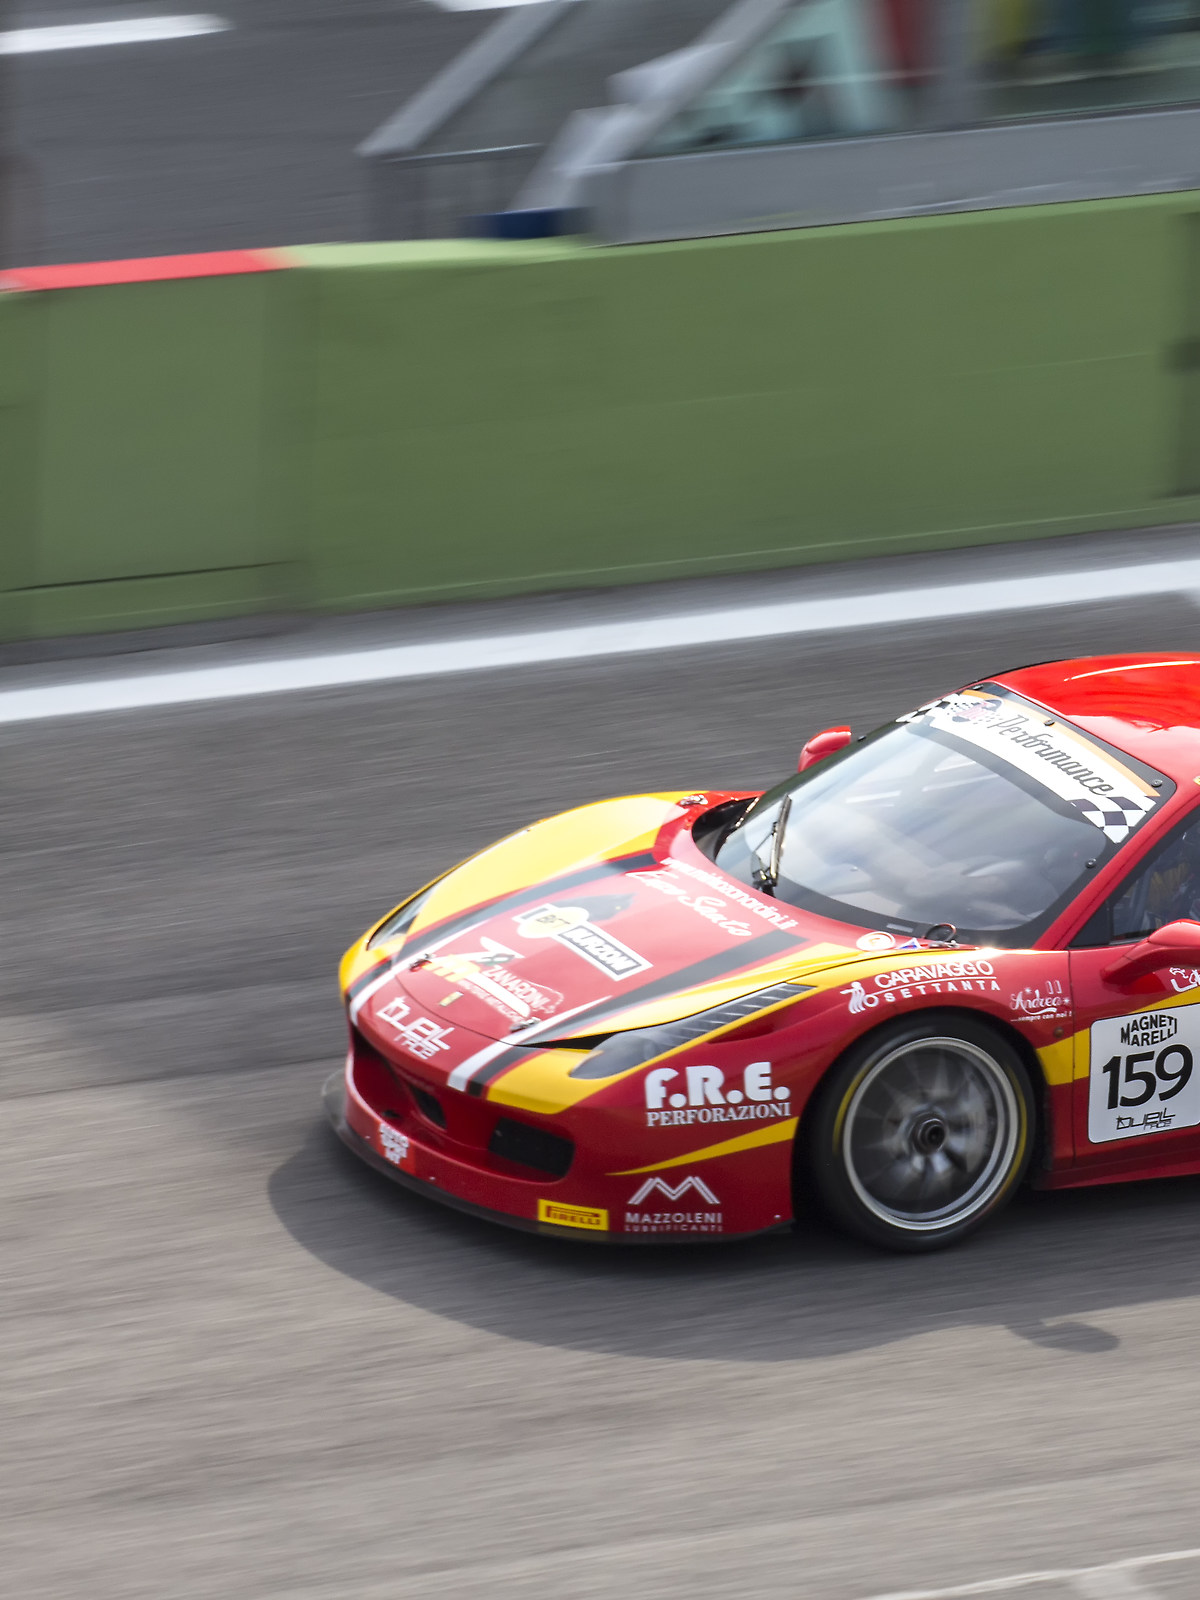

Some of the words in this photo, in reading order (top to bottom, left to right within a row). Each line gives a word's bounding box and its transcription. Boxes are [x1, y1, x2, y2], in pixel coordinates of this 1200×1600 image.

[987, 714, 1114, 796] Performance
[883, 980, 1001, 1003] SETTANTA
[645, 1061, 791, 1109] F.R.E.
[1102, 1044, 1193, 1110] 159
[646, 1102, 791, 1127] PERFORAZIONI
[545, 1205, 600, 1226] PIRELLI
[625, 1212, 723, 1224] MAZZOLENI
